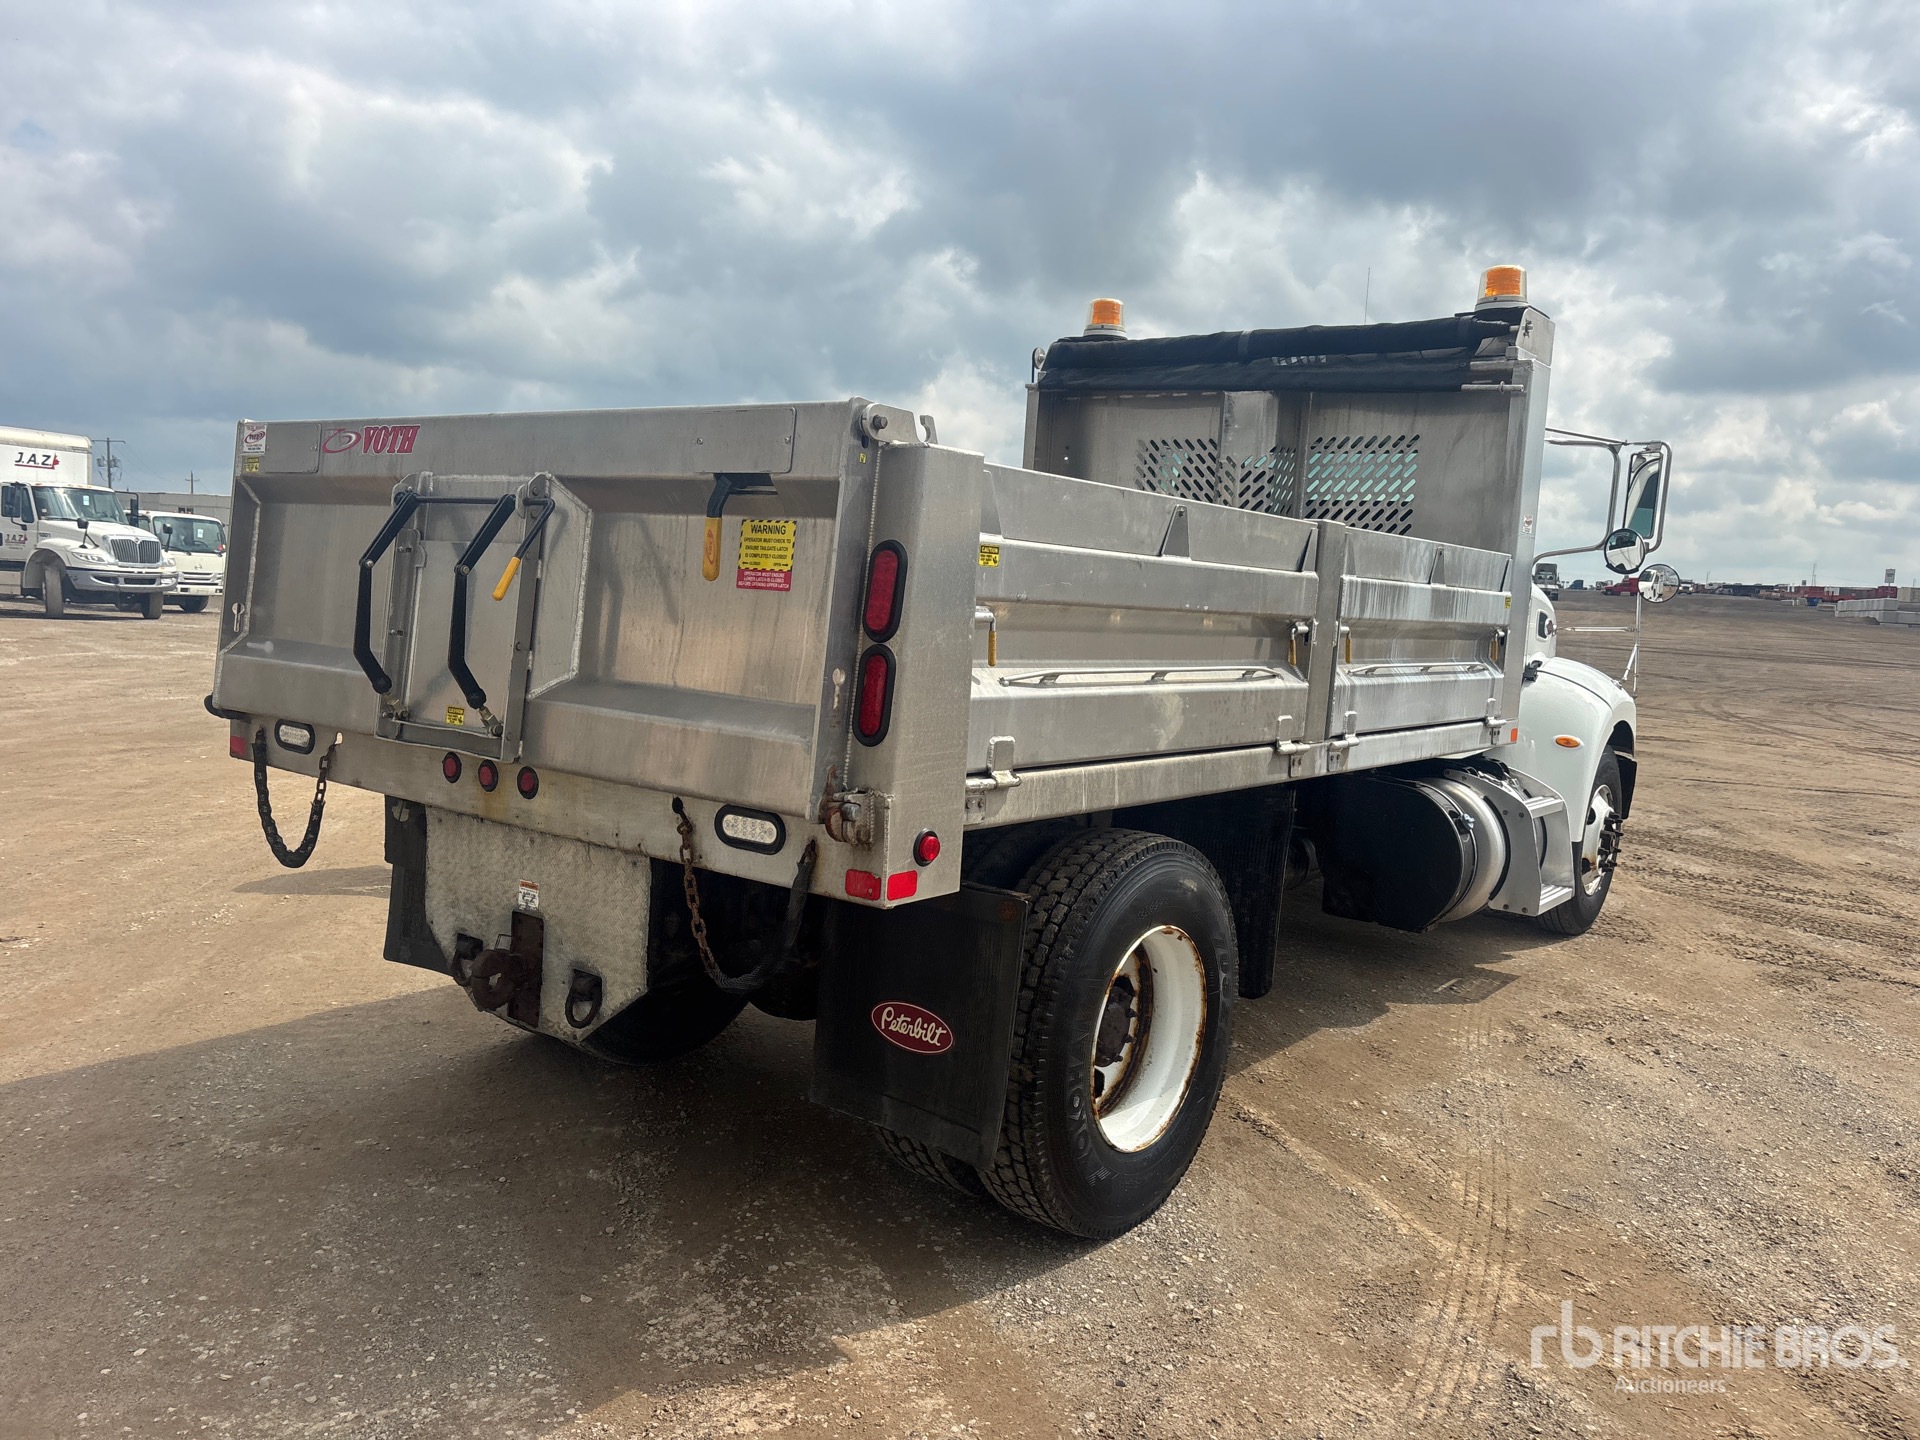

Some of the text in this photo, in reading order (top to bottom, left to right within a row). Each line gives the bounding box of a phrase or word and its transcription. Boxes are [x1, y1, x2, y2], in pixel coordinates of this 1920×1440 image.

[362, 424, 421, 455] VOTH
[751, 524, 786, 535] WARNING
[880, 1006, 947, 1046] Peterbilt
